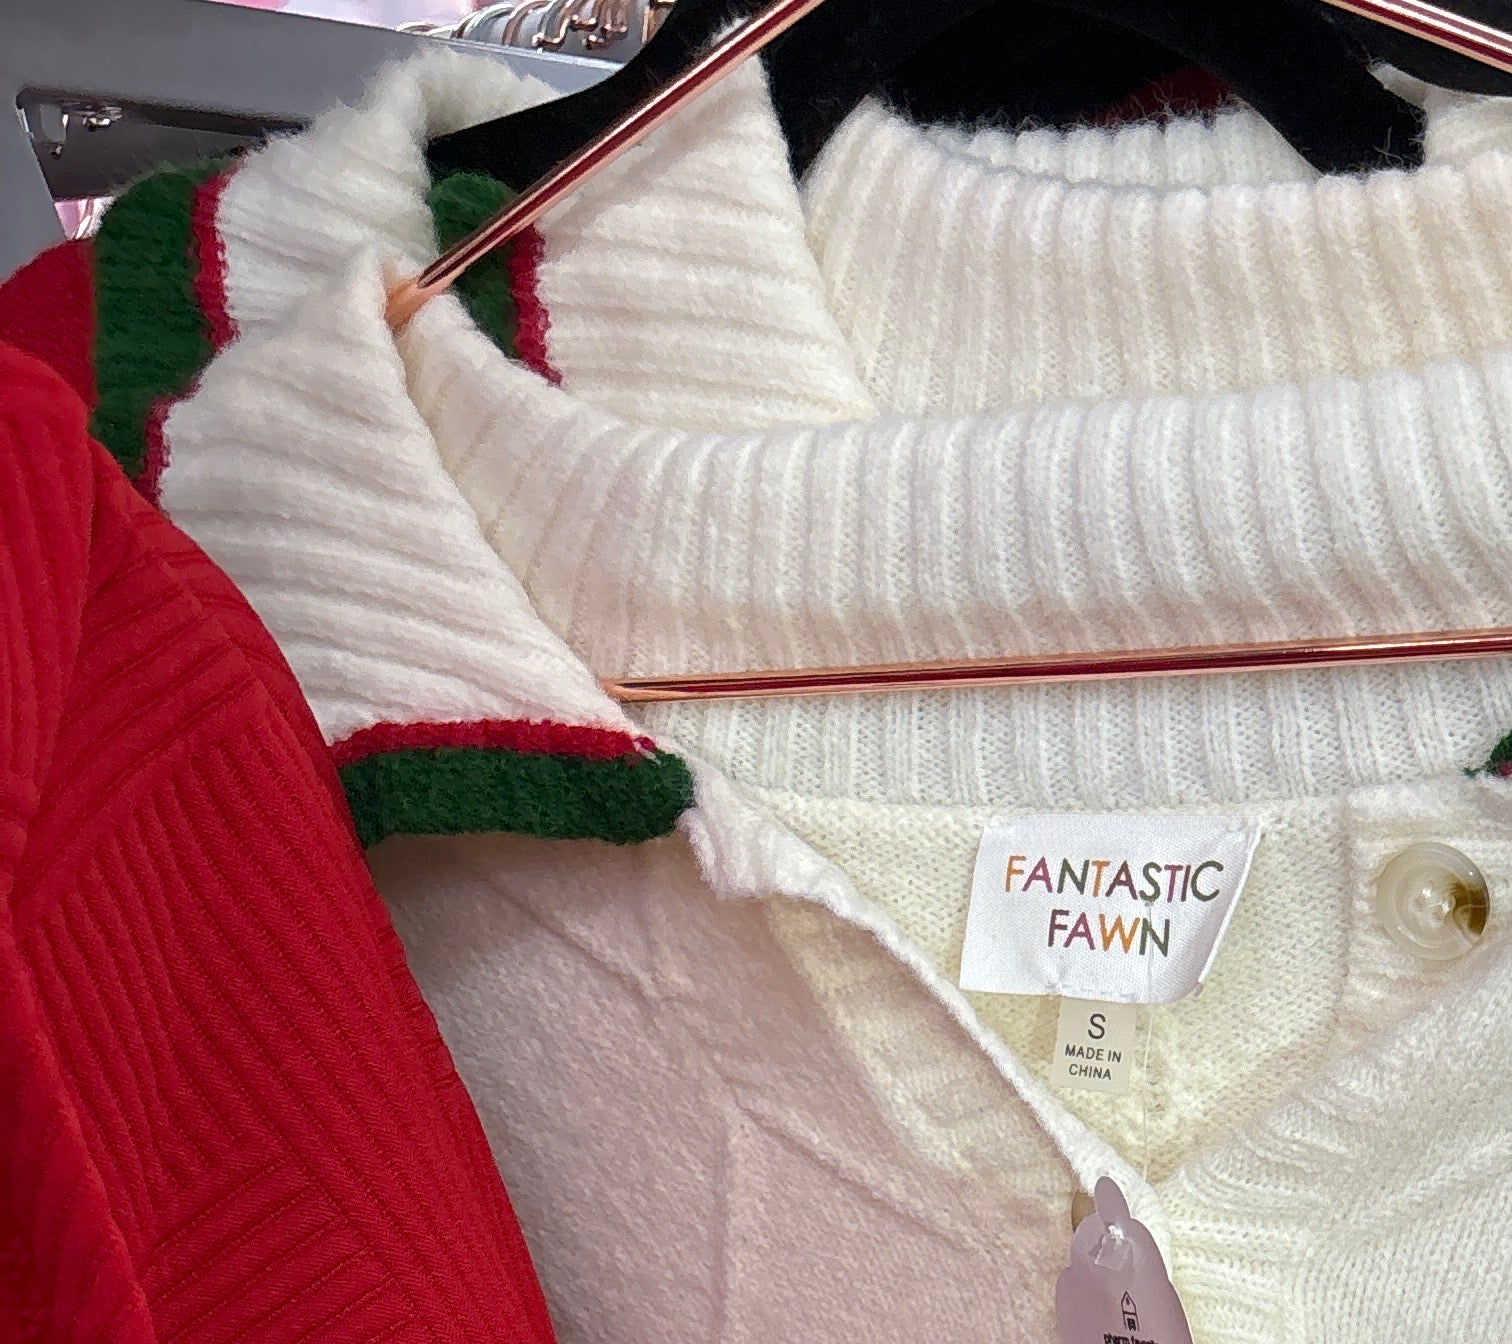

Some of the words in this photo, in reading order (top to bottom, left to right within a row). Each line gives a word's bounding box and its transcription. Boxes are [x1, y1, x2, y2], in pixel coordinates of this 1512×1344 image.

[1005, 855, 1223, 902] FANTASTIC
[1048, 909, 1170, 957] FAWN
[1087, 1013, 1106, 1039] S
[1064, 1043, 1104, 1061] MADE
[1107, 1049, 1122, 1063] IN
[1068, 1063, 1112, 1080] CHINA
